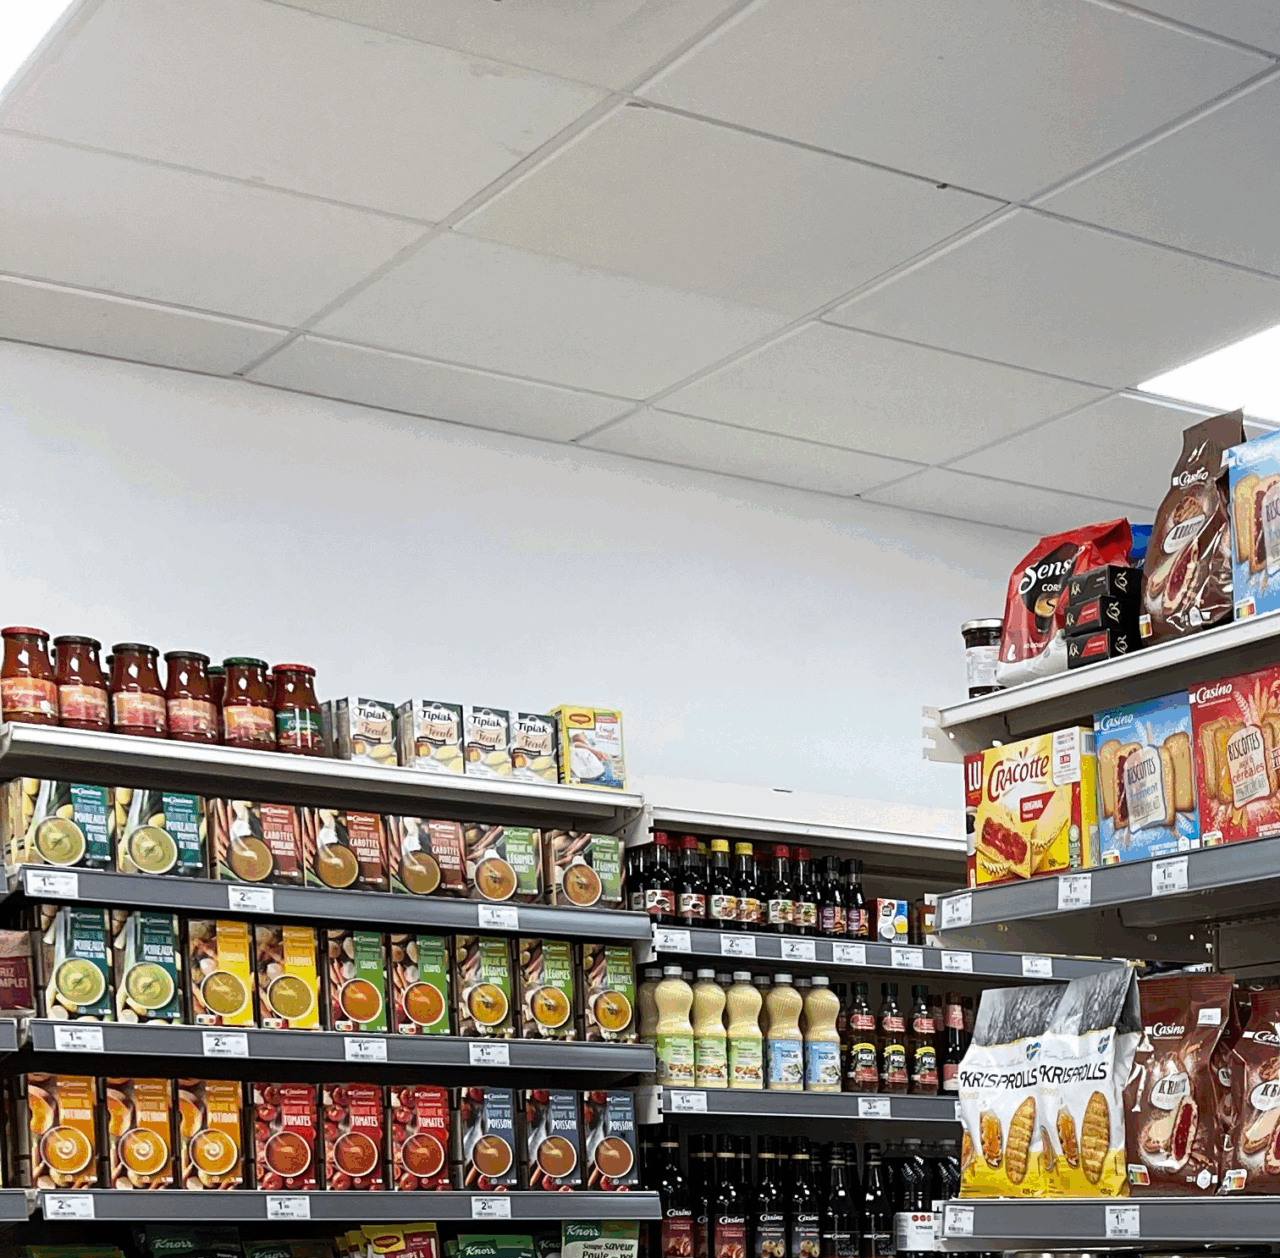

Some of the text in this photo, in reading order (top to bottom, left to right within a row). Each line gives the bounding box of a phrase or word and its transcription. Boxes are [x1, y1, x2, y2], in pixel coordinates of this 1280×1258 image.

[1197, 682, 1232, 703] Casino
[358, 708, 387, 720] Tipiak
[422, 709, 452, 722] Tipiak
[518, 722, 548, 733] Tipiak
[1228, 729, 1260, 762] BISCOTTES
[967, 764, 981, 790] LU
[1232, 764, 1264, 784] céréales
[1039, 1063, 1108, 1083] KRISPROLLS
[351, 1116, 378, 1127] TOMATES
[487, 1119, 512, 1128] POISSON
[567, 1225, 599, 1236] Knorr
[154, 1239, 193, 1249] Knorr
[604, 1242, 634, 1251] saveur
